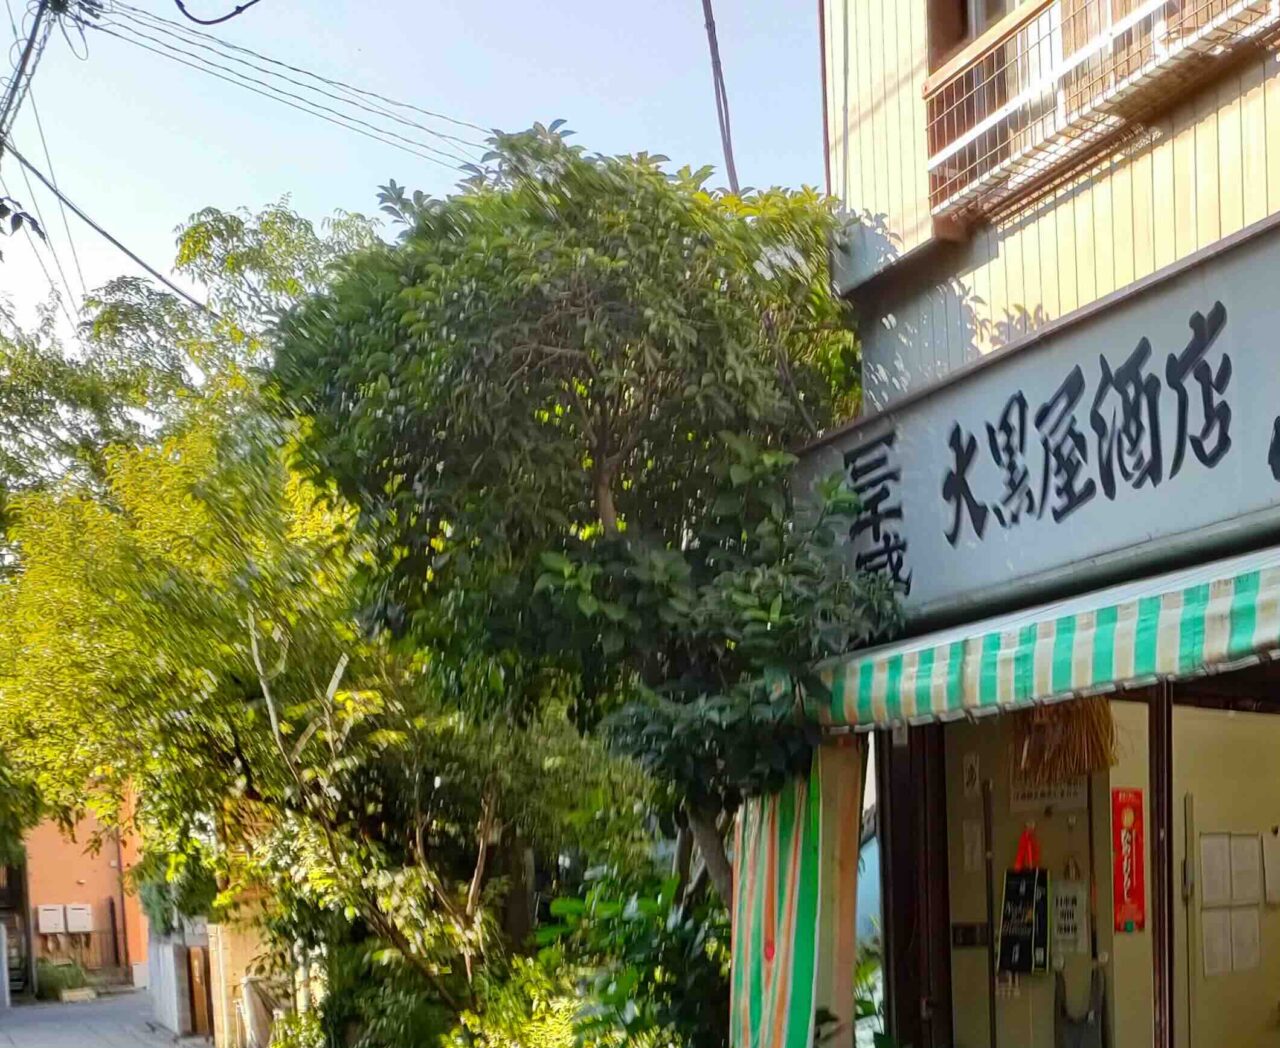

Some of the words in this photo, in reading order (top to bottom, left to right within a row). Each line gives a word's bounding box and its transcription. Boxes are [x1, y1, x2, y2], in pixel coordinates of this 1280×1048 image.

[942, 300, 1233, 550] 大黒屋酒店
